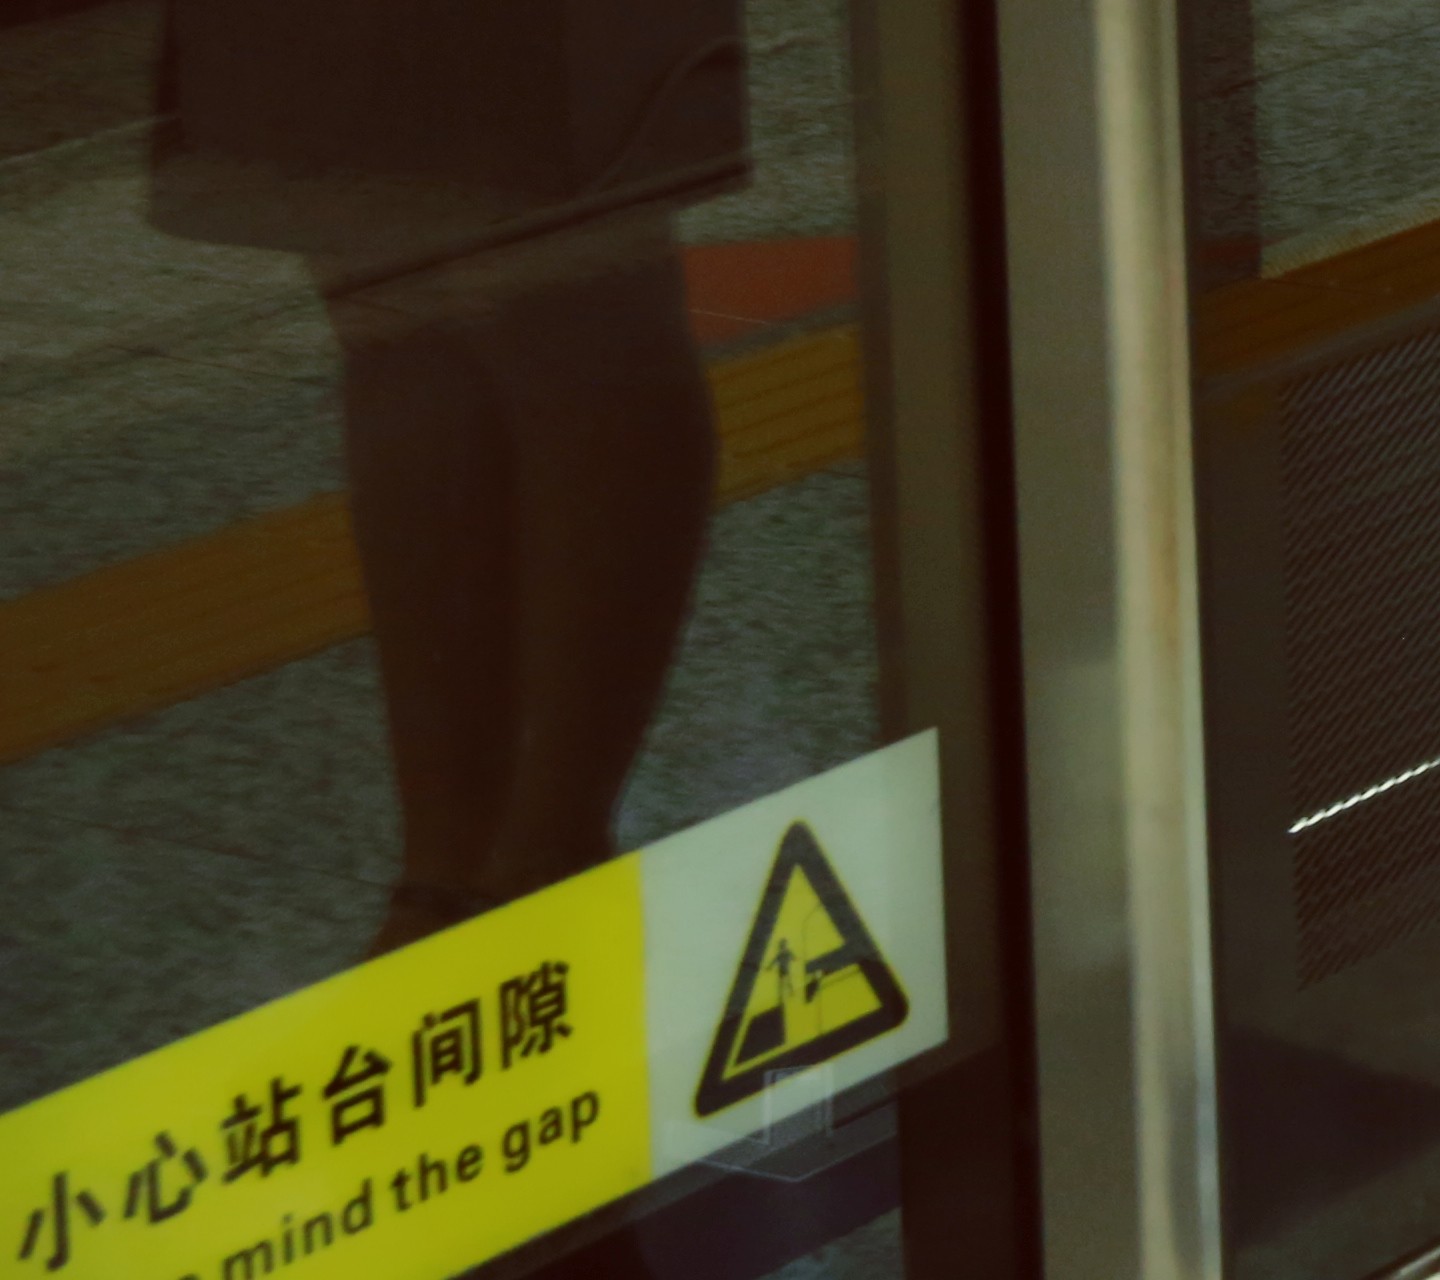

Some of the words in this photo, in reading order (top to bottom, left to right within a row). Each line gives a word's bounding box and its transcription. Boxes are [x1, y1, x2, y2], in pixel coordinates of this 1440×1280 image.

[17, 960, 574, 1273] 小心站台间隙
[218, 1177, 375, 1280] mind
[389, 1143, 485, 1213] the
[500, 1089, 600, 1175] gap
